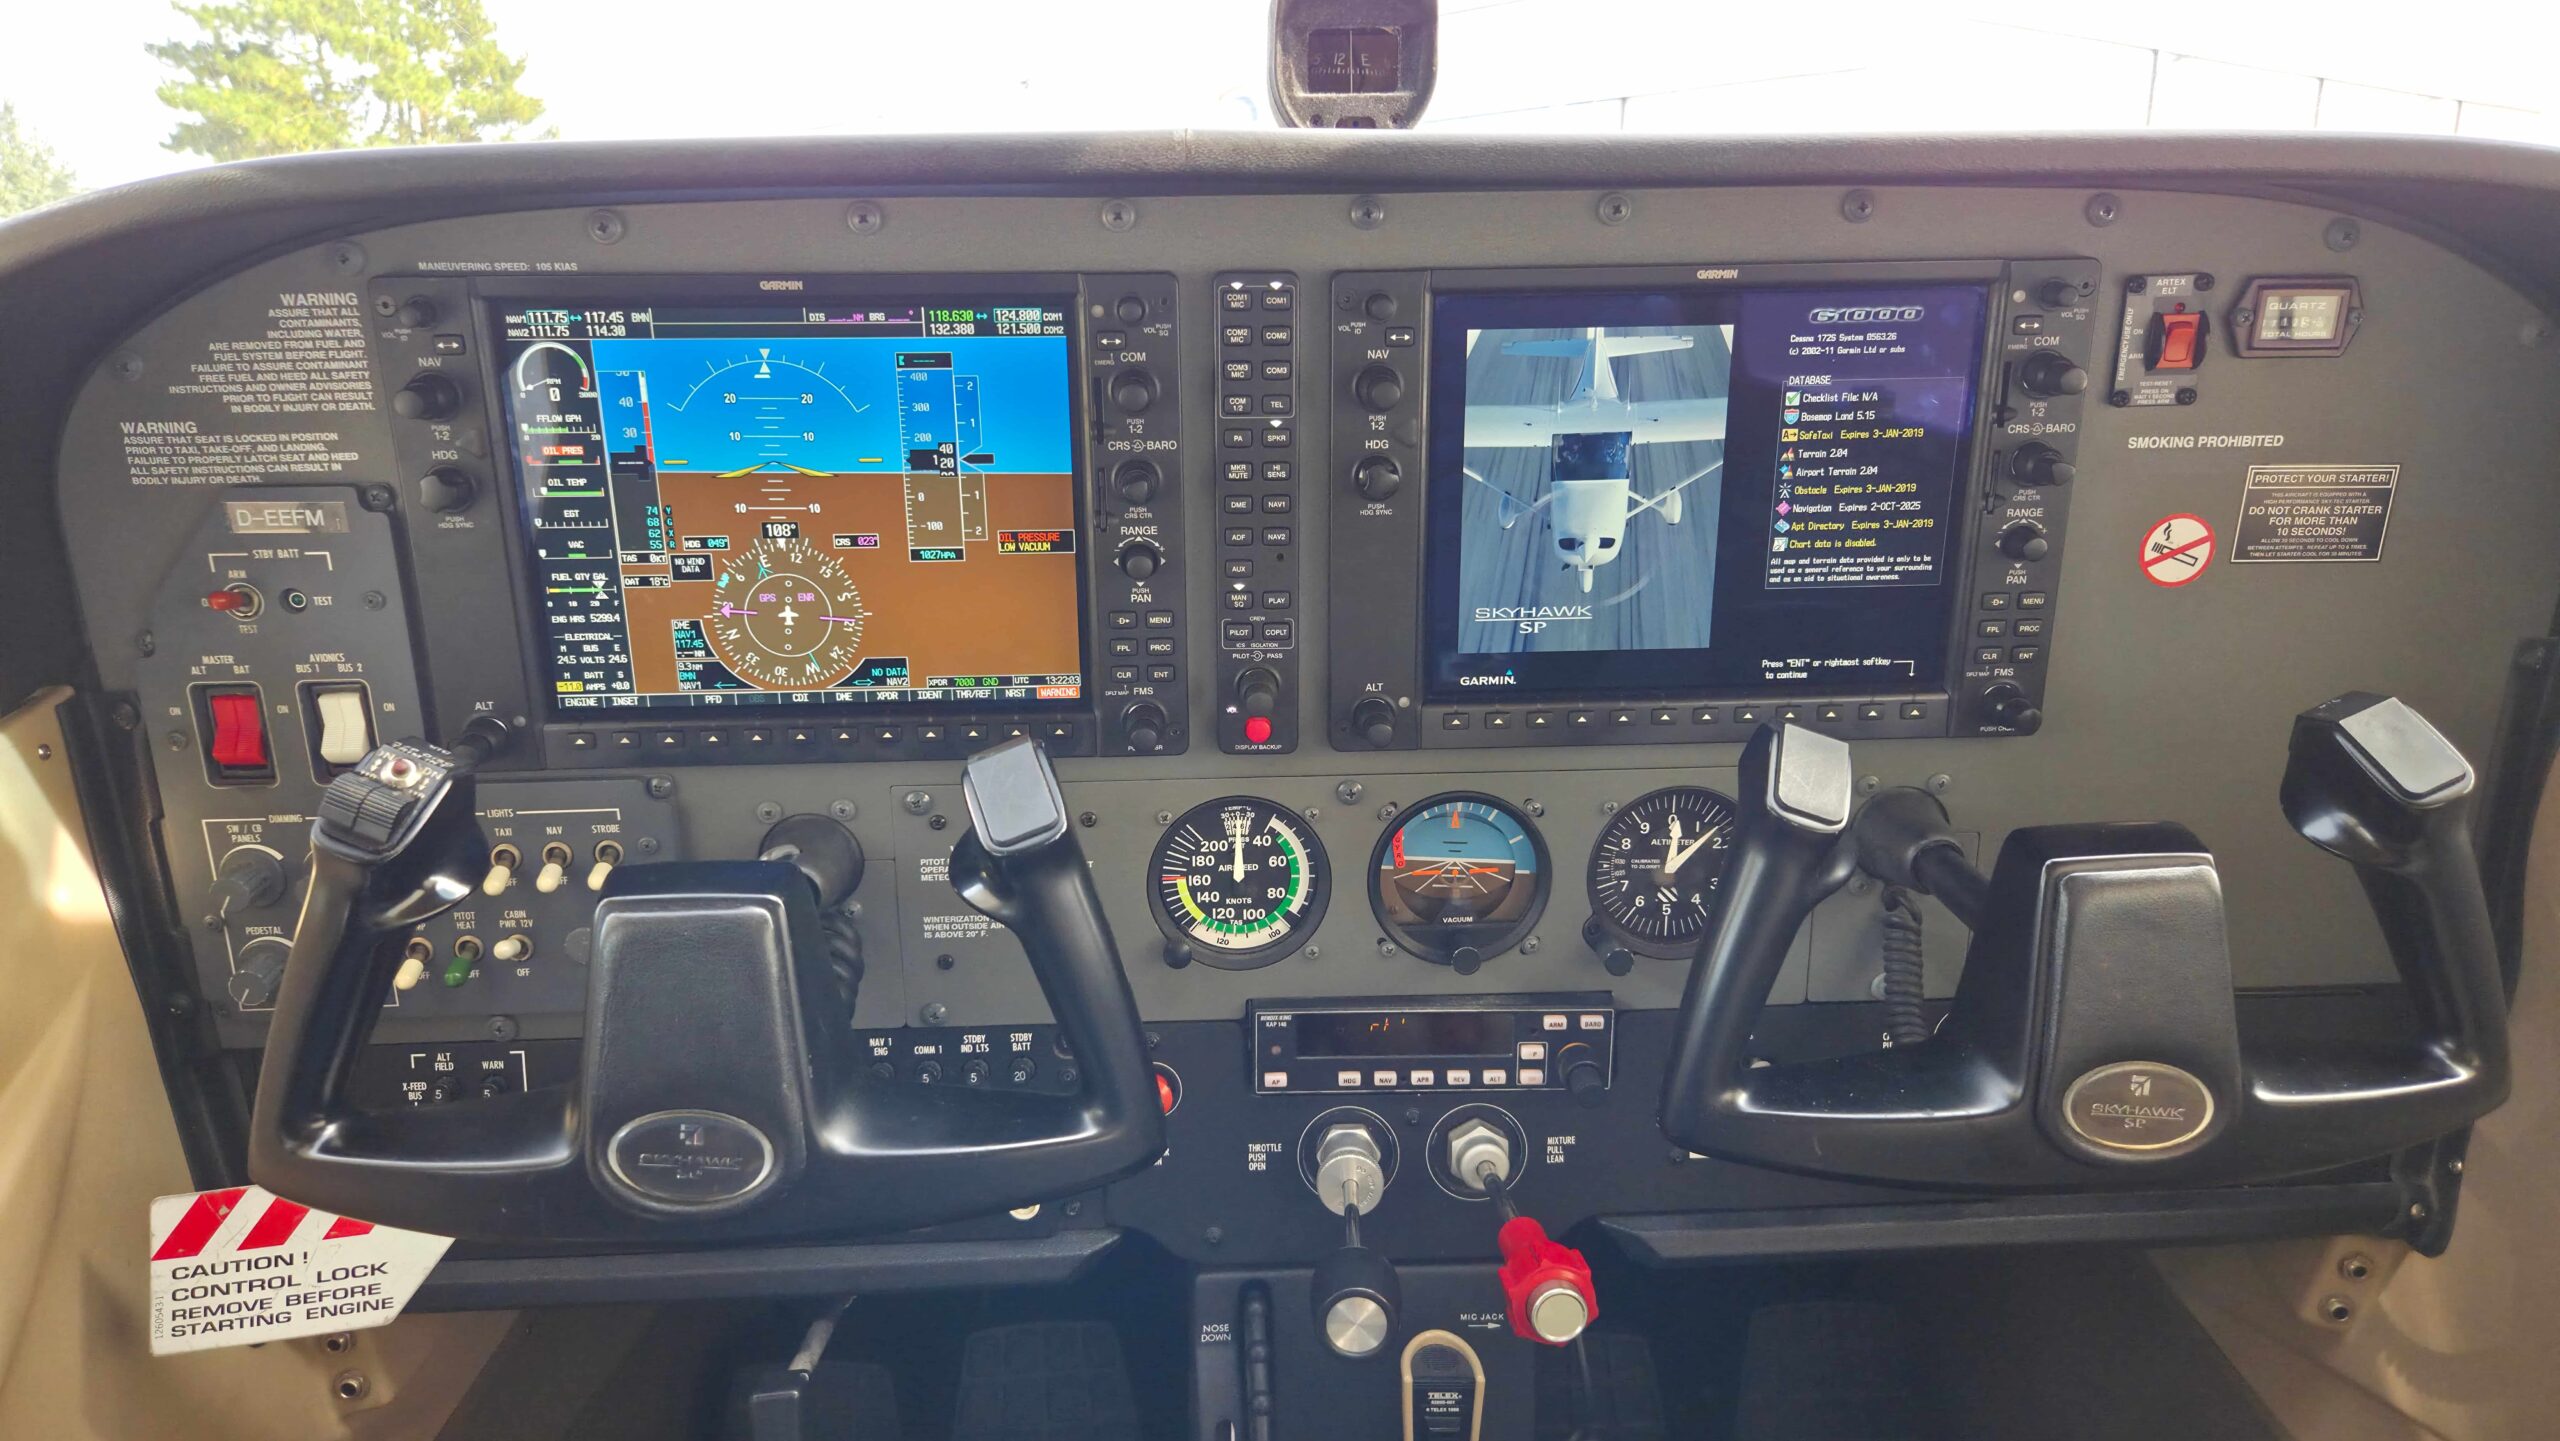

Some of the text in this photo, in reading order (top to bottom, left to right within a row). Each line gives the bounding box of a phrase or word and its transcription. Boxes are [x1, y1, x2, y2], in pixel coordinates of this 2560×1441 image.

[1334, 53, 1371, 66] 12 E
[418, 262, 578, 271] MANEUVERING SPEED: 105 KIAS
[1697, 269, 1738, 279] GARMIN
[759, 280, 803, 291] GARMIN
[280, 293, 358, 305] WARNING
[2269, 302, 2327, 310] QUARTZ
[506, 315, 527, 323] NAV1
[528, 312, 568, 323] 111.75
[584, 312, 624, 324] 117.45
[929, 310, 1062, 322] 118.630 124.800 COM1
[507, 325, 626, 337] NAV2 111.75 114.30
[930, 323, 1063, 335] 132.380 121.500 COM2
[1120, 352, 1146, 362] COM
[1789, 376, 1831, 385] DATABASE
[1801, 411, 1875, 422] Basemap Land 5.15
[120, 422, 198, 433] WARNING
[235, 434, 277, 442] LOCKED
[291, 433, 338, 441] POSITION
[1799, 429, 1923, 440] SafeTaxi Expires 3-JAN-2019
[1108, 440, 1130, 451] CRS
[1146, 440, 1177, 450] BARO
[2128, 434, 2284, 449] SMOKING PROHIBITED
[2255, 474, 2389, 483] PROTECT YOUR STARTER!
[1792, 501, 1921, 513] Navigation Expires 2-OCT-2025
[2249, 506, 2382, 515] DO NOT CRANK STARTER
[236, 509, 325, 527] D-EEFM
[2269, 516, 2357, 525] FOR MORE THAN
[765, 524, 796, 537] 108°
[1120, 526, 1157, 536] RANGE
[2277, 527, 2346, 536] 10 SECONDS!
[999, 532, 1060, 542] OIL PRESSURE
[999, 542, 1051, 552] LOW VACUUM
[253, 549, 299, 559] STBY BATT
[313, 596, 333, 606] TEST
[1131, 594, 1151, 603] PAN
[1475, 605, 1592, 619] SKYHAWK
[570, 615, 585, 623] HRS
[590, 614, 620, 623] 5299.4
[1519, 622, 1547, 633] SP
[202, 655, 234, 665] MASTER
[309, 653, 345, 663] AVIONICS
[1762, 660, 1783, 668] Press
[1787, 659, 1810, 667] "ENT"
[1824, 658, 1859, 667] rightmost
[1863, 658, 1891, 666] softkey
[191, 666, 206, 675] ALT
[234, 666, 249, 674] BAT
[296, 664, 320, 673] BUS 1
[338, 663, 362, 673] BUS 2
[1015, 675, 1080, 685] UTC 13:22:03
[566, 687, 1078, 706] ENGINE INSET PFD CDI DME XPDR IDENT TMR/REF NRST WARNING
[1133, 687, 1153, 696] FMS
[487, 808, 514, 818] LIGHTS
[495, 827, 513, 837] TAXI
[546, 826, 562, 835] NAV
[591, 824, 620, 834] STROBE
[1253, 835, 1271, 846] 40
[1201, 841, 1228, 852] 200
[1192, 856, 1215, 866] 180
[1269, 856, 1287, 867] 60
[1189, 875, 1211, 886] 160
[1197, 892, 1220, 903] 140
[1267, 888, 1285, 898] 80
[454, 912, 475, 921] PITOT
[1213, 908, 1235, 919] 120
[1243, 909, 1265, 920] 100
[456, 920, 475, 929] HEAT
[1442, 916, 1473, 924] VACUUM
[2091, 1103, 2186, 1117] SKYHAWK
[2124, 1118, 2146, 1128] SP
[1547, 1136, 1575, 1145] MIXTURE
[1249, 1143, 1282, 1152] THROTTLE
[1547, 1146, 1563, 1154] PULL
[1249, 1153, 1266, 1161] PUSH
[1547, 1155, 1564, 1163] LEAN
[1249, 1162, 1266, 1171] OPEN
[171, 1252, 308, 1280] CAUTION !
[172, 1262, 388, 1301] CONTROL LOCK
[172, 1283, 382, 1321] REMOVE BEFORE
[171, 1297, 394, 1337] STARTING ENGINE
[1460, 1313, 1476, 1321] MIC
[1203, 1324, 1230, 1333] NOSE
[1201, 1333, 1231, 1343] DOWN
